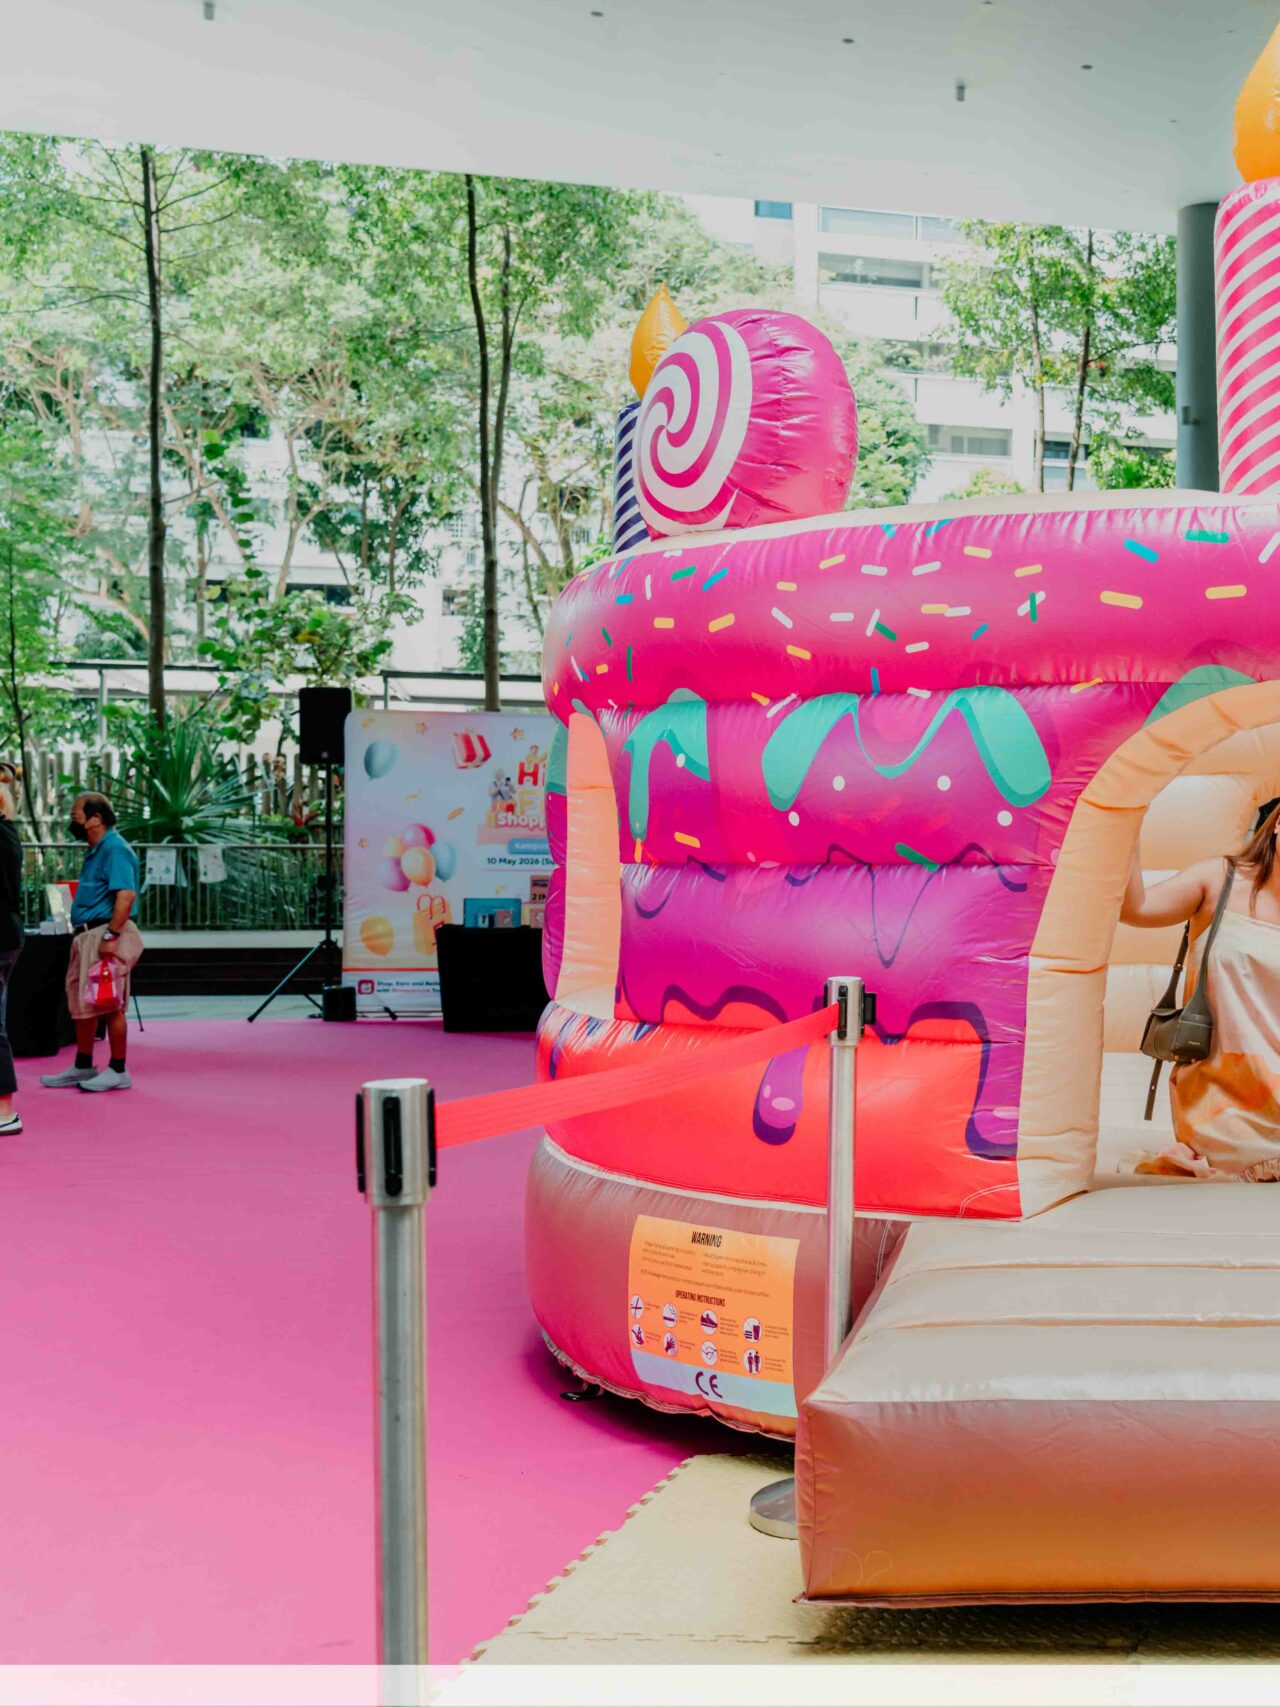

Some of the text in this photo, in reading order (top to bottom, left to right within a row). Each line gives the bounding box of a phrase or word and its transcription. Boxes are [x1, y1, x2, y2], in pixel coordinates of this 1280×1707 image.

[487, 857, 555, 866] 10 May 2026 (Su
[691, 1231, 723, 1248] WARNING
